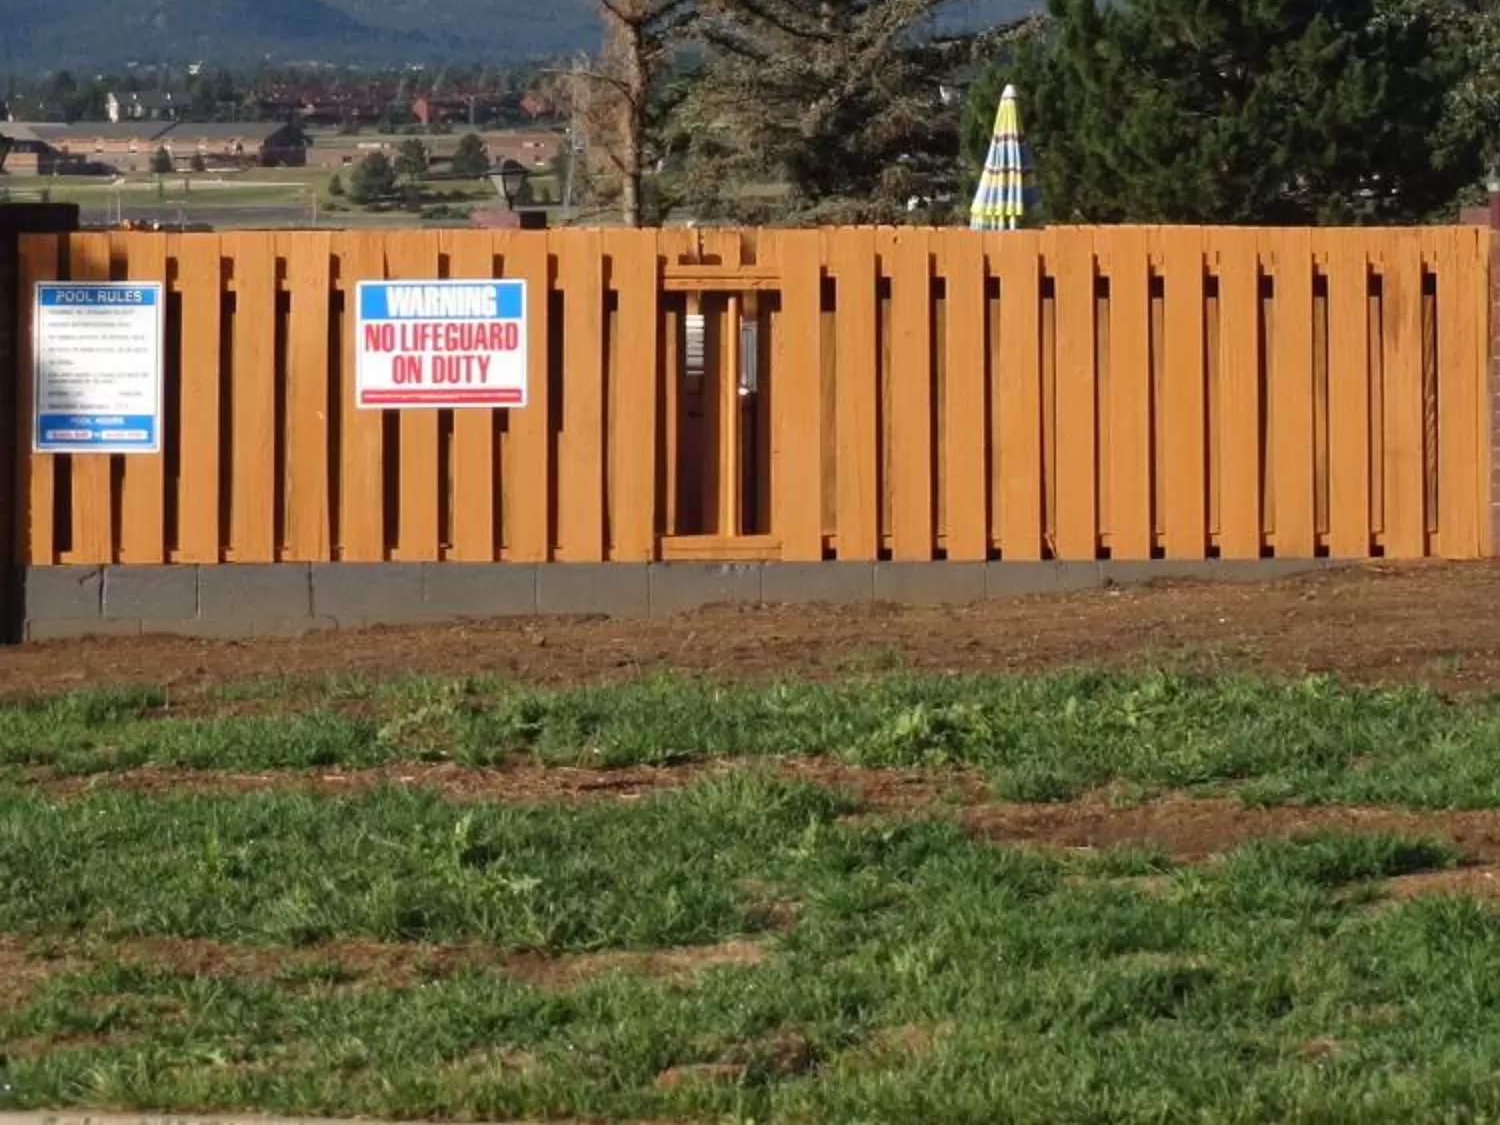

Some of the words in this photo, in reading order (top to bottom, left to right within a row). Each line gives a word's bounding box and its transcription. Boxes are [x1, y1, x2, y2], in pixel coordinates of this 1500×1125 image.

[55, 290, 94, 303] POOL
[98, 290, 143, 303] RULES
[386, 286, 497, 317] WARNING
[365, 323, 395, 352] NO
[401, 323, 519, 352] LIFEGUARD
[392, 355, 423, 384] ON
[432, 355, 492, 384] DUTY
